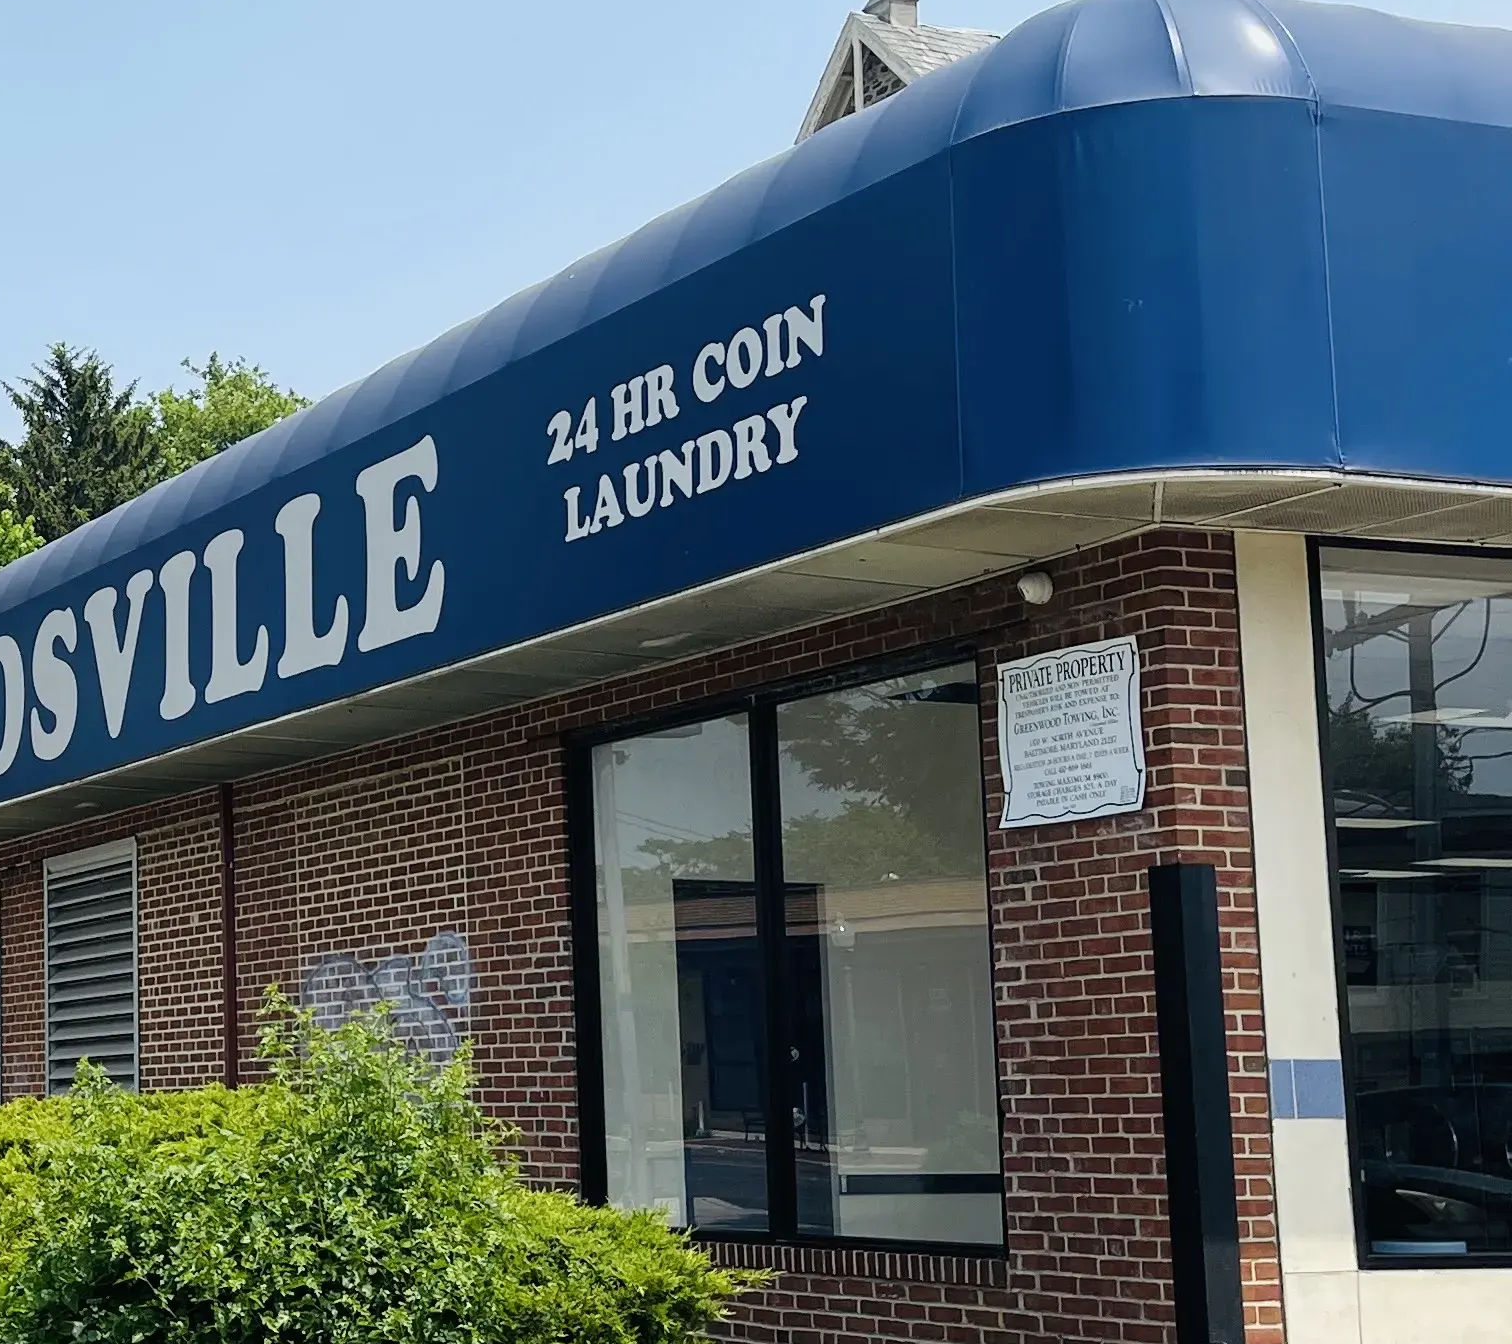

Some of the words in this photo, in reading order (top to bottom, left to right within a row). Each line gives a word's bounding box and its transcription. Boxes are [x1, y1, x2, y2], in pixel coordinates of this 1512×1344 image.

[547, 396, 598, 465] 24
[611, 364, 680, 441] HR
[692, 293, 826, 403] COIN
[563, 395, 808, 542] LAUNDRY
[1008, 665, 1053, 694] PRIVATE
[1055, 650, 1125, 683] PROPERTY
